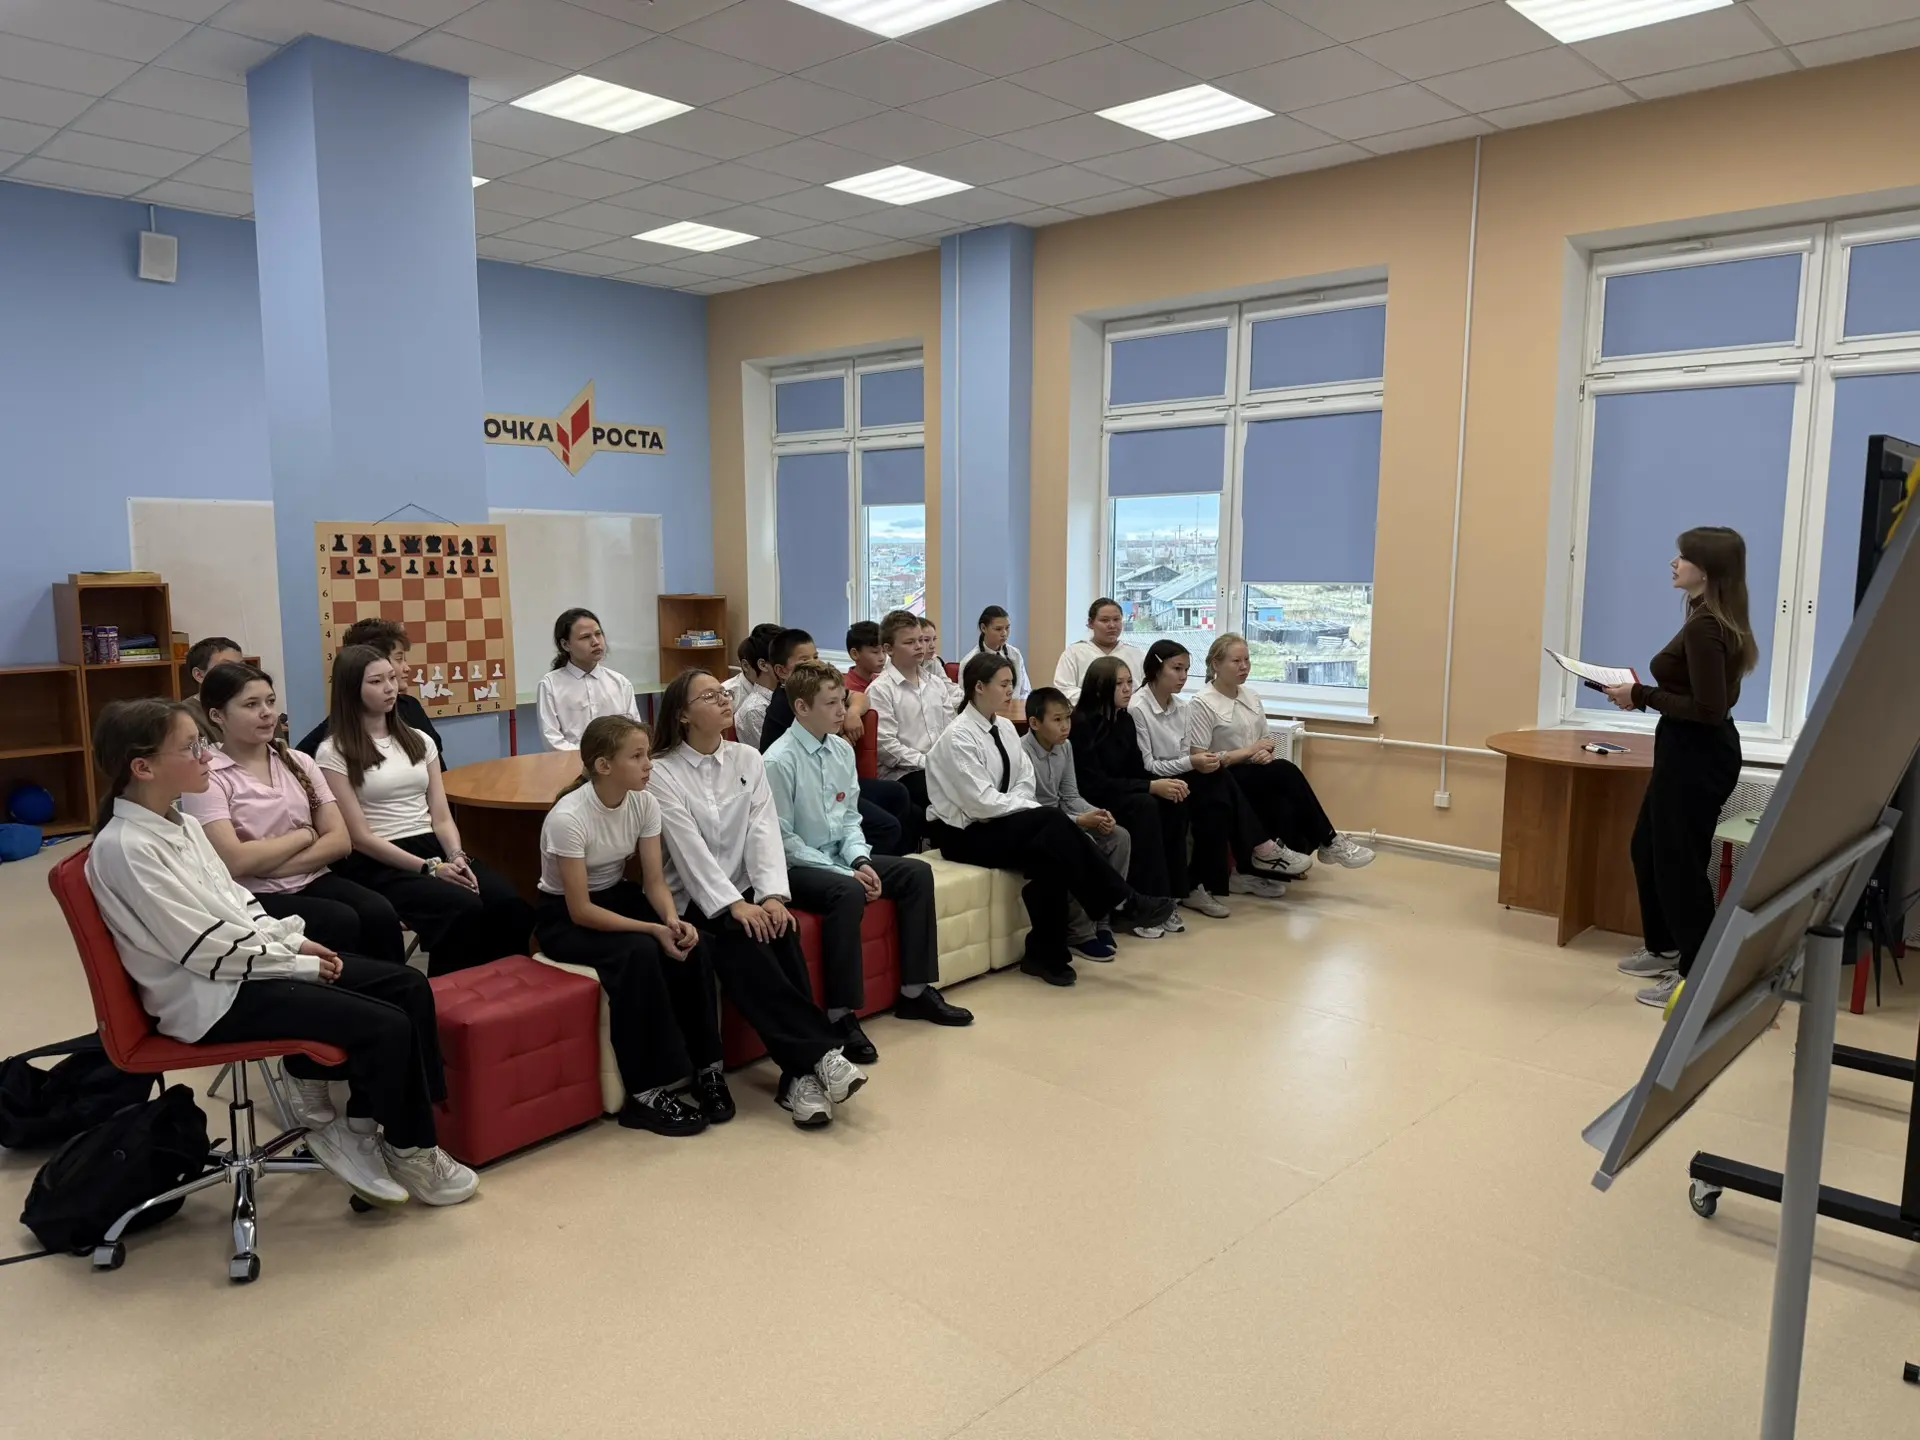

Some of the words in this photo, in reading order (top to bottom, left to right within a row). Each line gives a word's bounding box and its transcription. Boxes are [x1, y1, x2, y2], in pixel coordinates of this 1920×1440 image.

[592, 426, 663, 450] РОСТА
[320, 543, 326, 552] 8
[321, 567, 327, 575] 7
[322, 589, 328, 598] 6
[324, 612, 330, 620] 5
[325, 630, 331, 638] 4
[327, 653, 333, 661] 3
[457, 704, 462, 713] f
[476, 703, 482, 712] g
[495, 701, 501, 709] h
